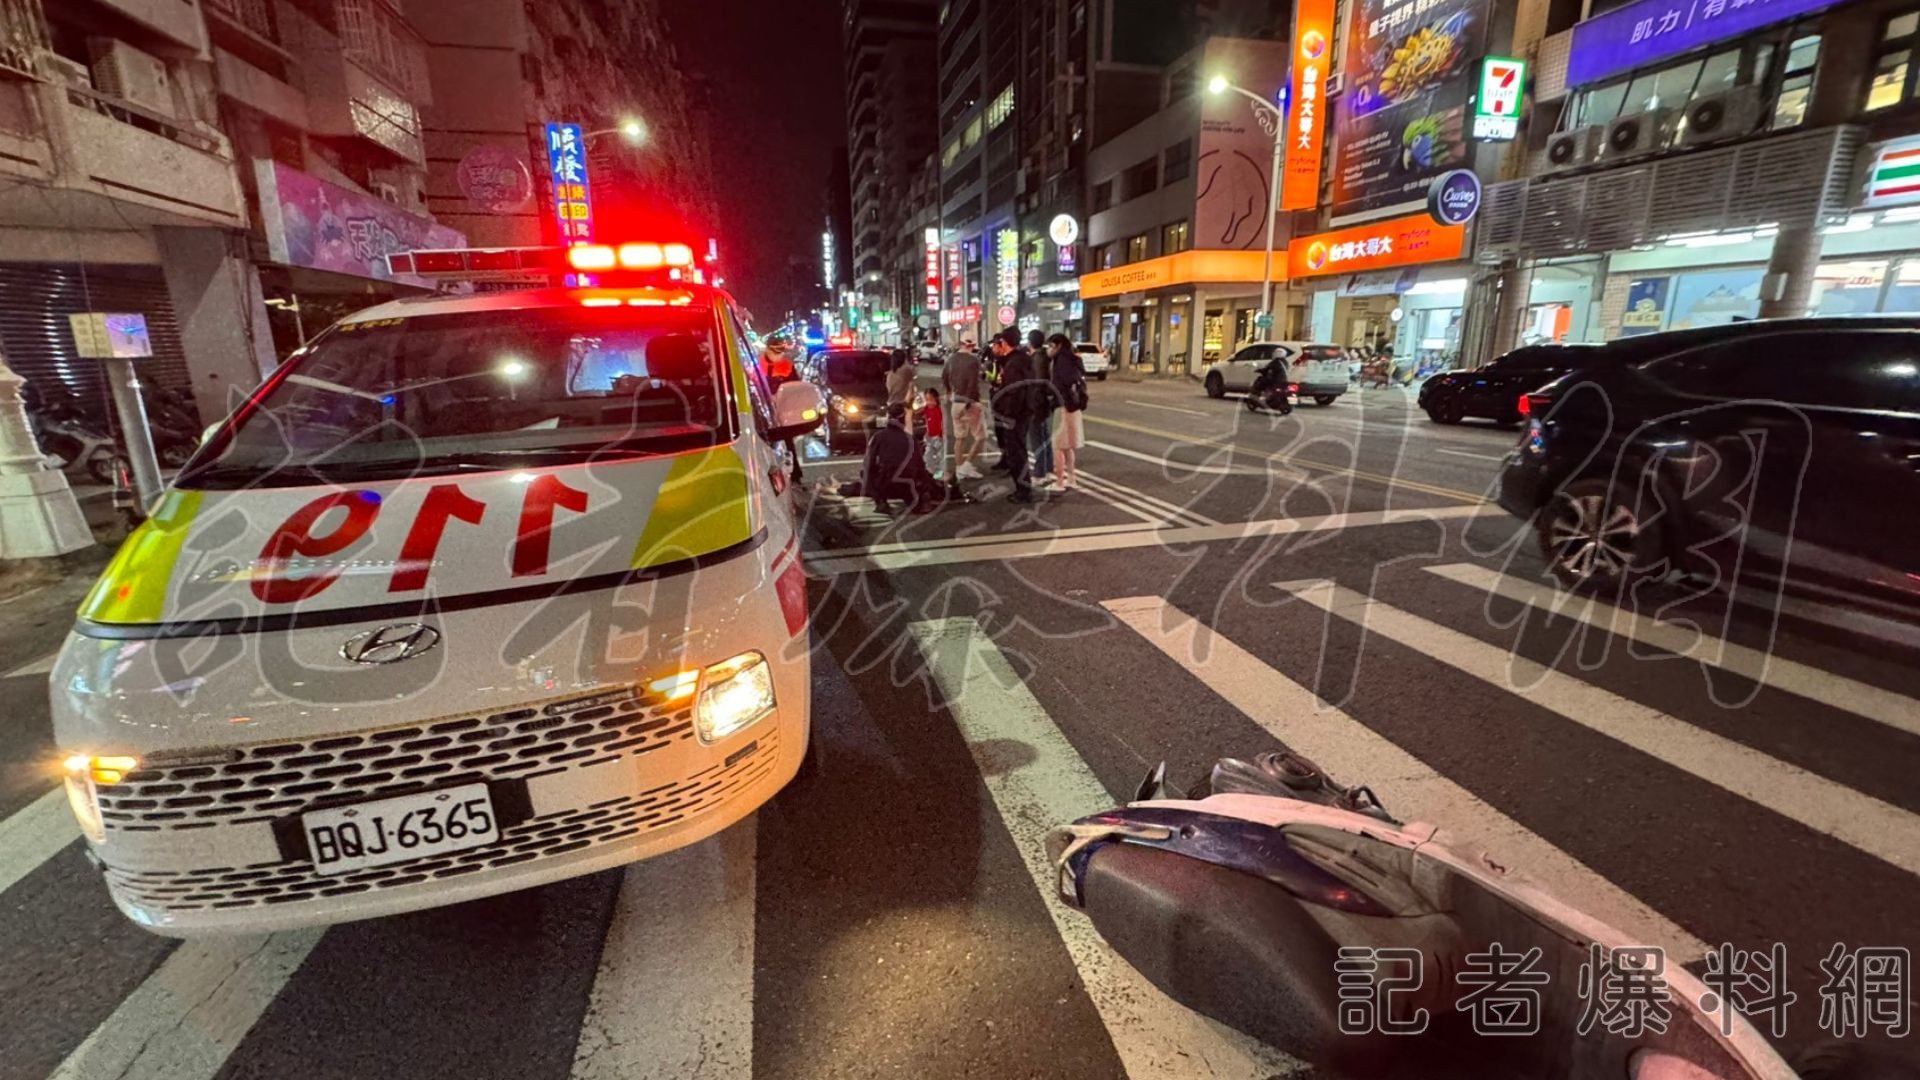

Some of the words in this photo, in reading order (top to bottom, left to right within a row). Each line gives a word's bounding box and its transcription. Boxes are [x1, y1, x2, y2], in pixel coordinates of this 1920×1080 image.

[1298, 65, 1319, 150] 台灣大哥大
[1442, 187, 1476, 203] Curves
[1328, 236, 1394, 262] 台灣大哥大
[1100, 276, 1122, 289] LOUISA
[1122, 270, 1146, 285] COFFEE
